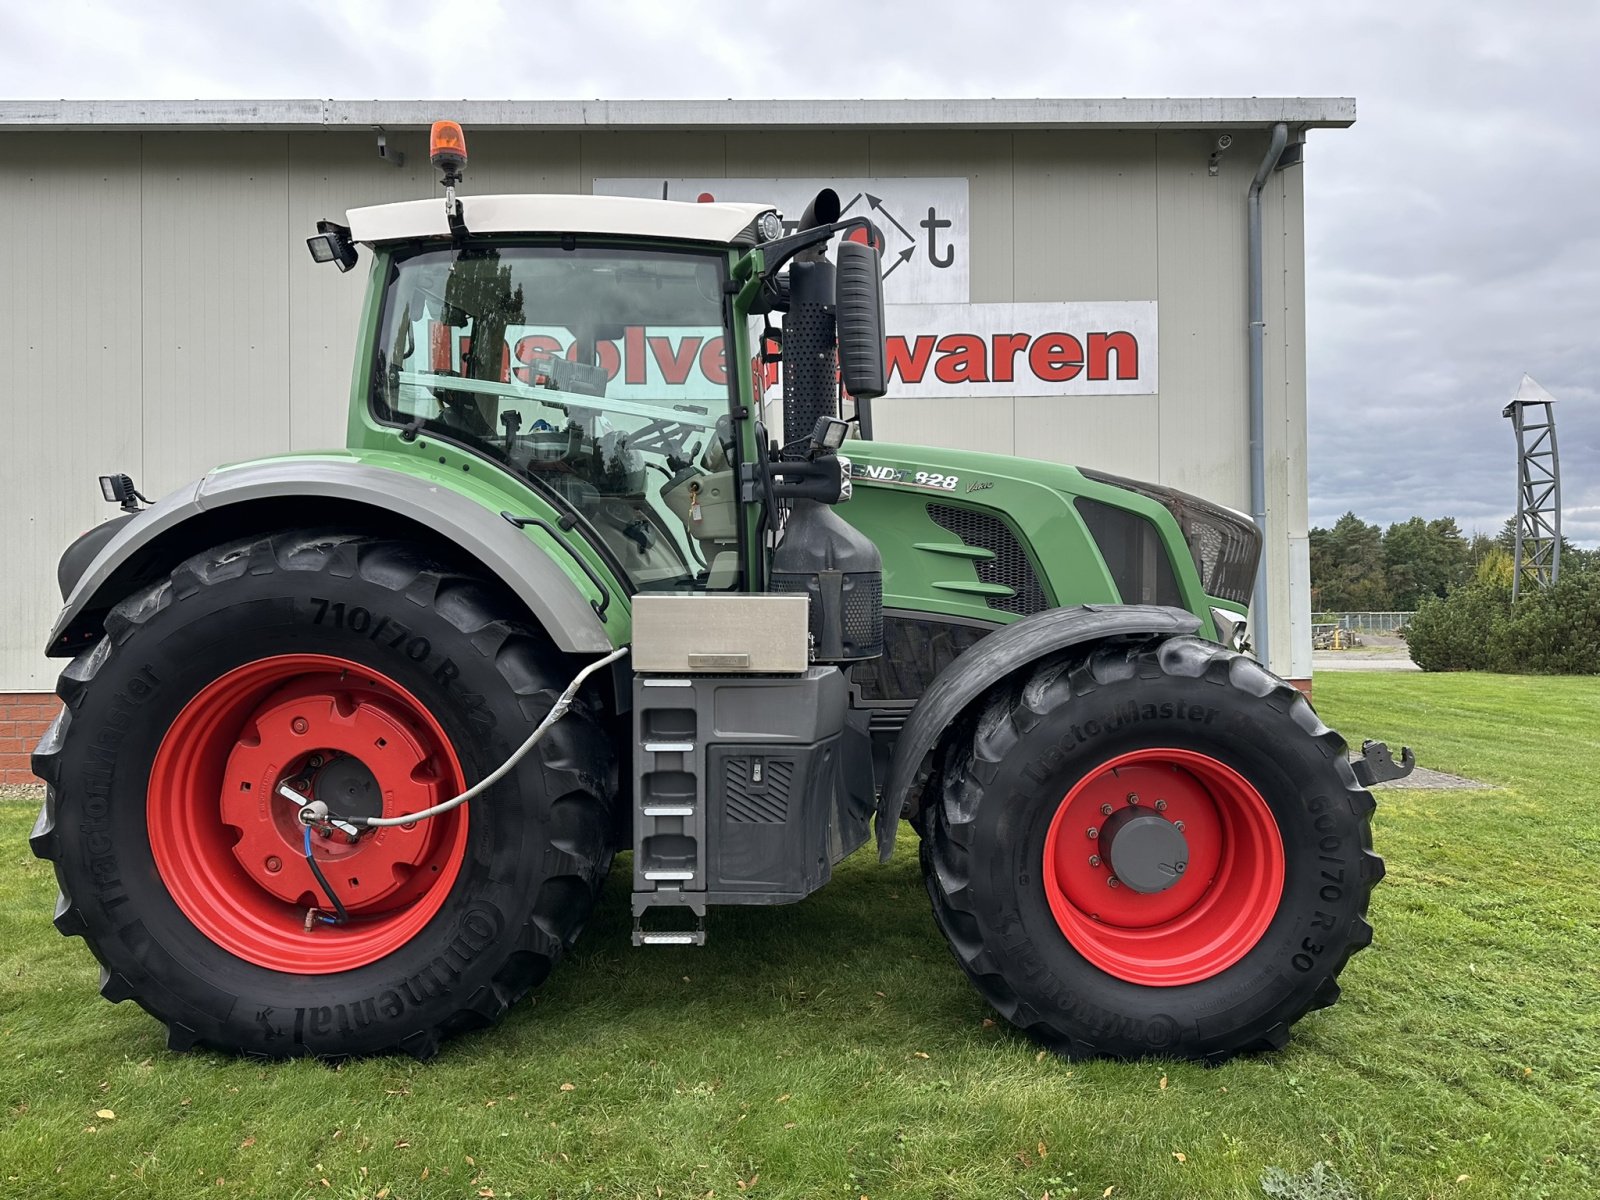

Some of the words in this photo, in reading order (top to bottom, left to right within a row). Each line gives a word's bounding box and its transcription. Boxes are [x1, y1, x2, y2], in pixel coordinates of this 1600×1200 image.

[851, 463, 912, 482] ENDT
[914, 472, 959, 489] 828
[310, 597, 431, 662] 710/70
[433, 657, 460, 689] R
[1019, 699, 1221, 785] TractorMaster
[80, 663, 162, 919] TractorMaster
[1307, 795, 1345, 902] 600/70
[1290, 936, 1325, 973] 30
[1310, 910, 1337, 931] R
